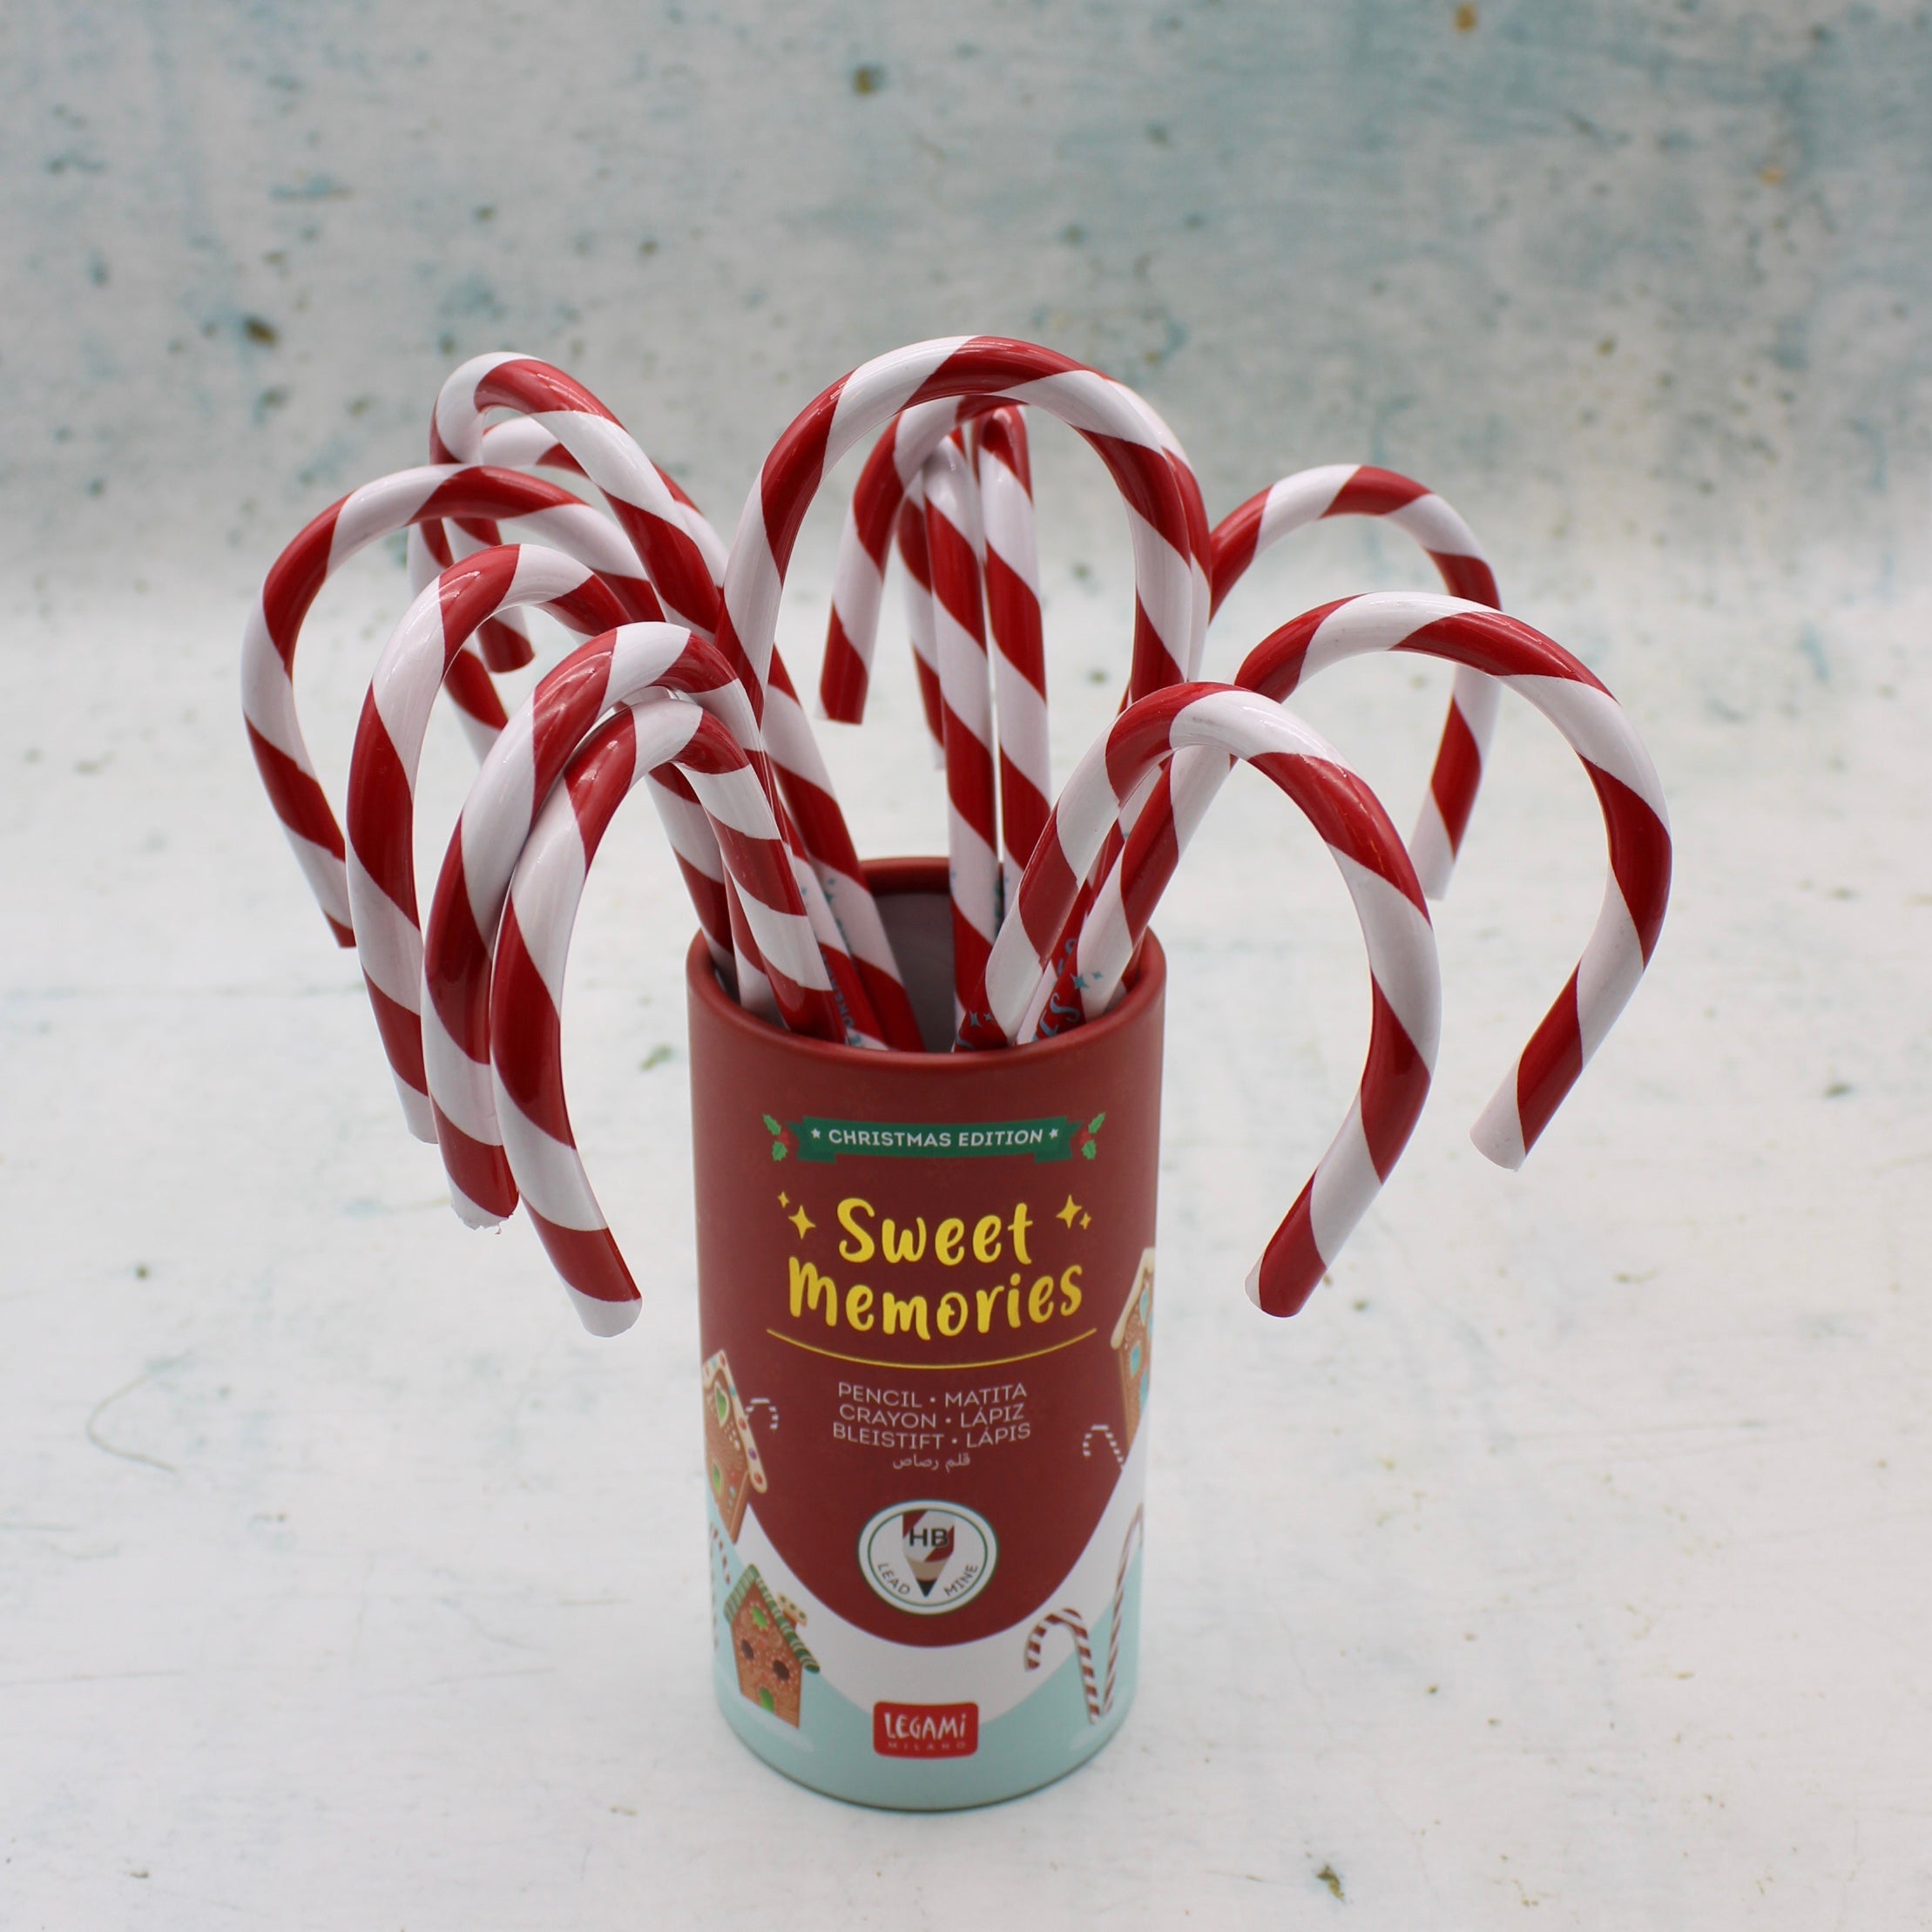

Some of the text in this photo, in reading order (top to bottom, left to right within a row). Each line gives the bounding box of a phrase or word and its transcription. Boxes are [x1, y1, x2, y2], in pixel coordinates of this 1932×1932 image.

[828, 1128, 1044, 1147] CHRISTMAS EDITION
[837, 1198, 1033, 1266] Sweet
[838, 1381, 1027, 1408] PENCIL MATITA
[839, 1403, 1024, 1429] CRAYON LÁPIZ
[833, 1422, 1030, 1450] BLEISTIFT LÁPIS
[892, 1452, 970, 1474] قلم رصاص
[909, 1528, 949, 1547] HB
[878, 1563, 978, 1597] LEAD MINE
[888, 1740, 966, 1751] MILANO
